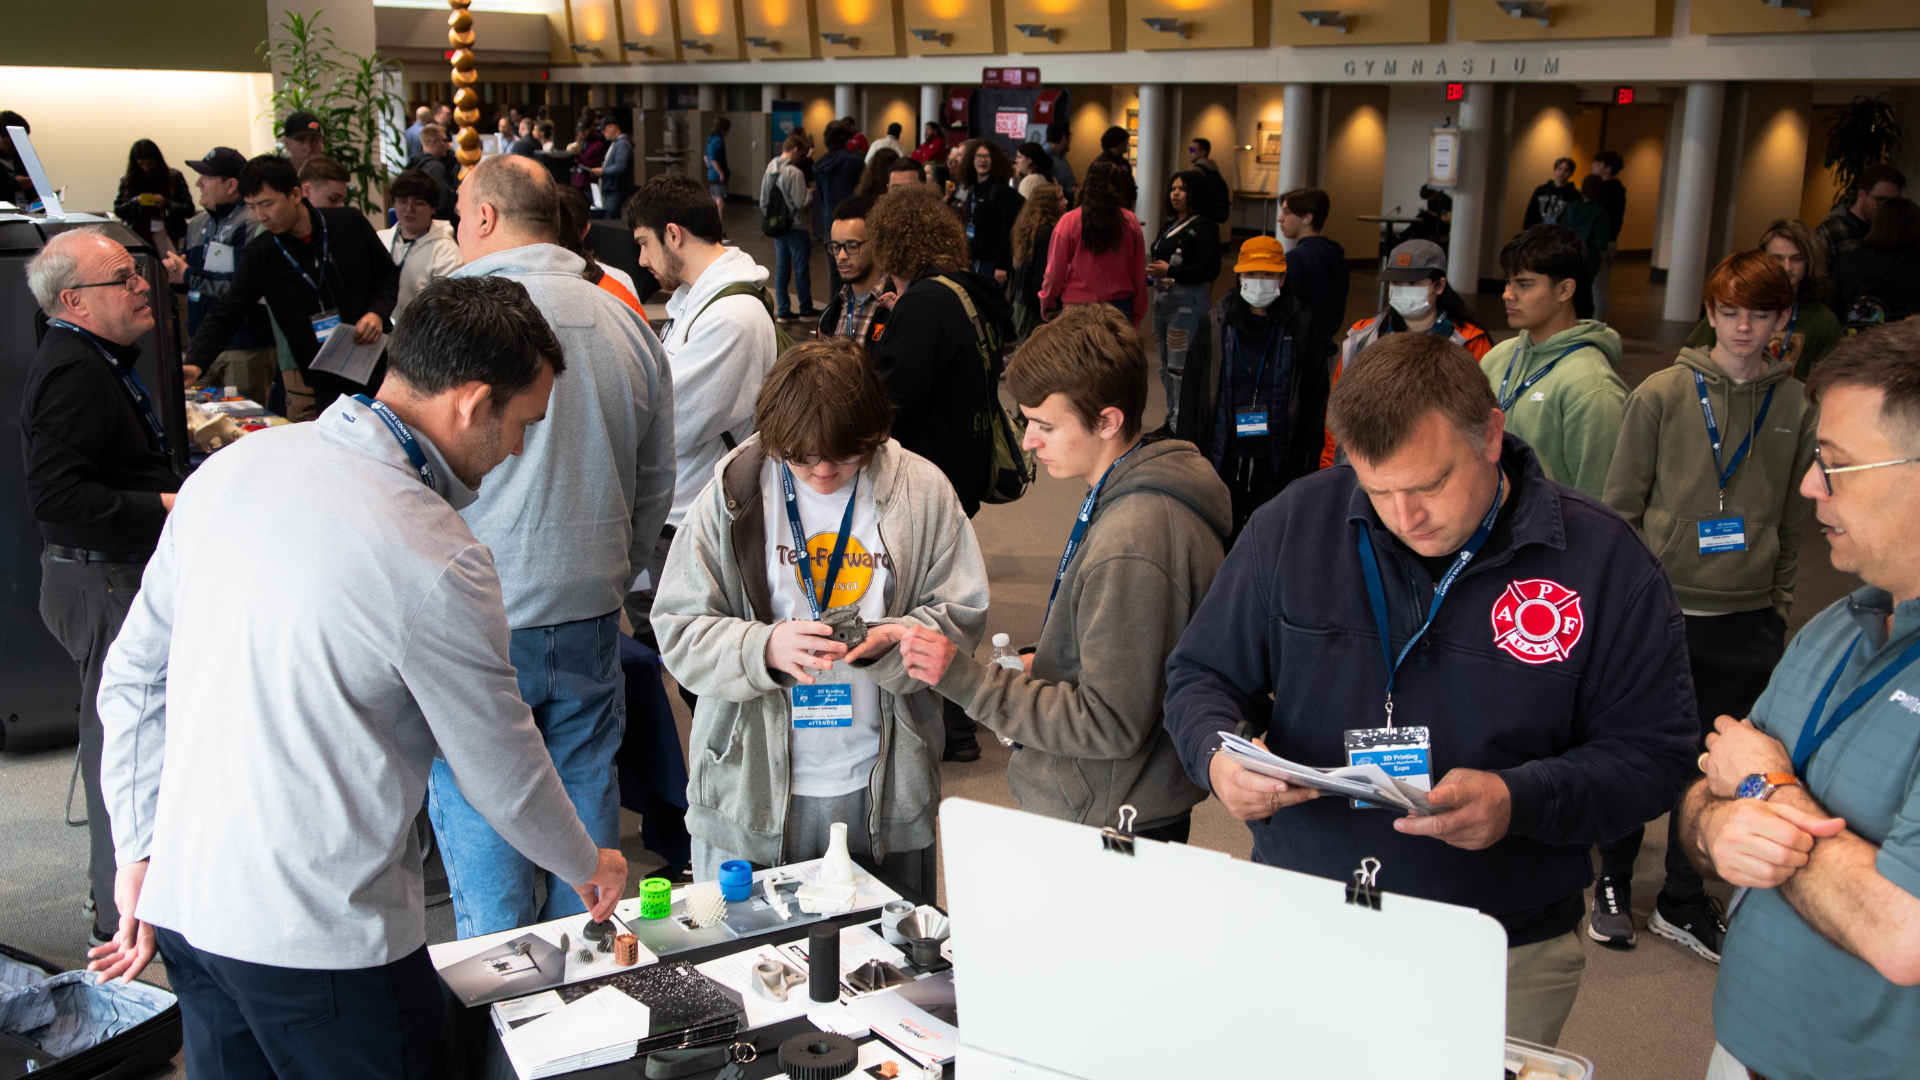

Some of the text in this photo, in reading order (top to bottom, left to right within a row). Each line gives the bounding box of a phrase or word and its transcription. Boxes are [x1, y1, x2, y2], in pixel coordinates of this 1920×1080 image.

[1344, 57, 1559, 76] GYMNASIUM
[1447, 83, 1464, 100] EXIT
[1618, 88, 1635, 104] EXIT
[997, 121, 1018, 132] SOLID
[377, 409, 407, 444] COMMUNITY COLLEGE
[381, 405, 412, 440] BUCKS COUNTY
[1481, 510, 1493, 526] COLLEGE
[790, 520, 798, 537] COUNTY
[776, 545, 891, 569] Te-Frwar
[1059, 539, 1073, 571] BUCKS COUNTY
[1435, 557, 1461, 594] COMMUNITY COLLEGE
[1439, 560, 1466, 596] BUCKS COUNTY
[803, 578, 812, 597] COUNTY
[814, 580, 859, 591] ONGE
[1537, 583, 1553, 599] P
[1496, 605, 1513, 622] A
[1561, 616, 1579, 635] F
[1514, 638, 1549, 653] UAV
[898, 1022, 927, 1039] Phillips
